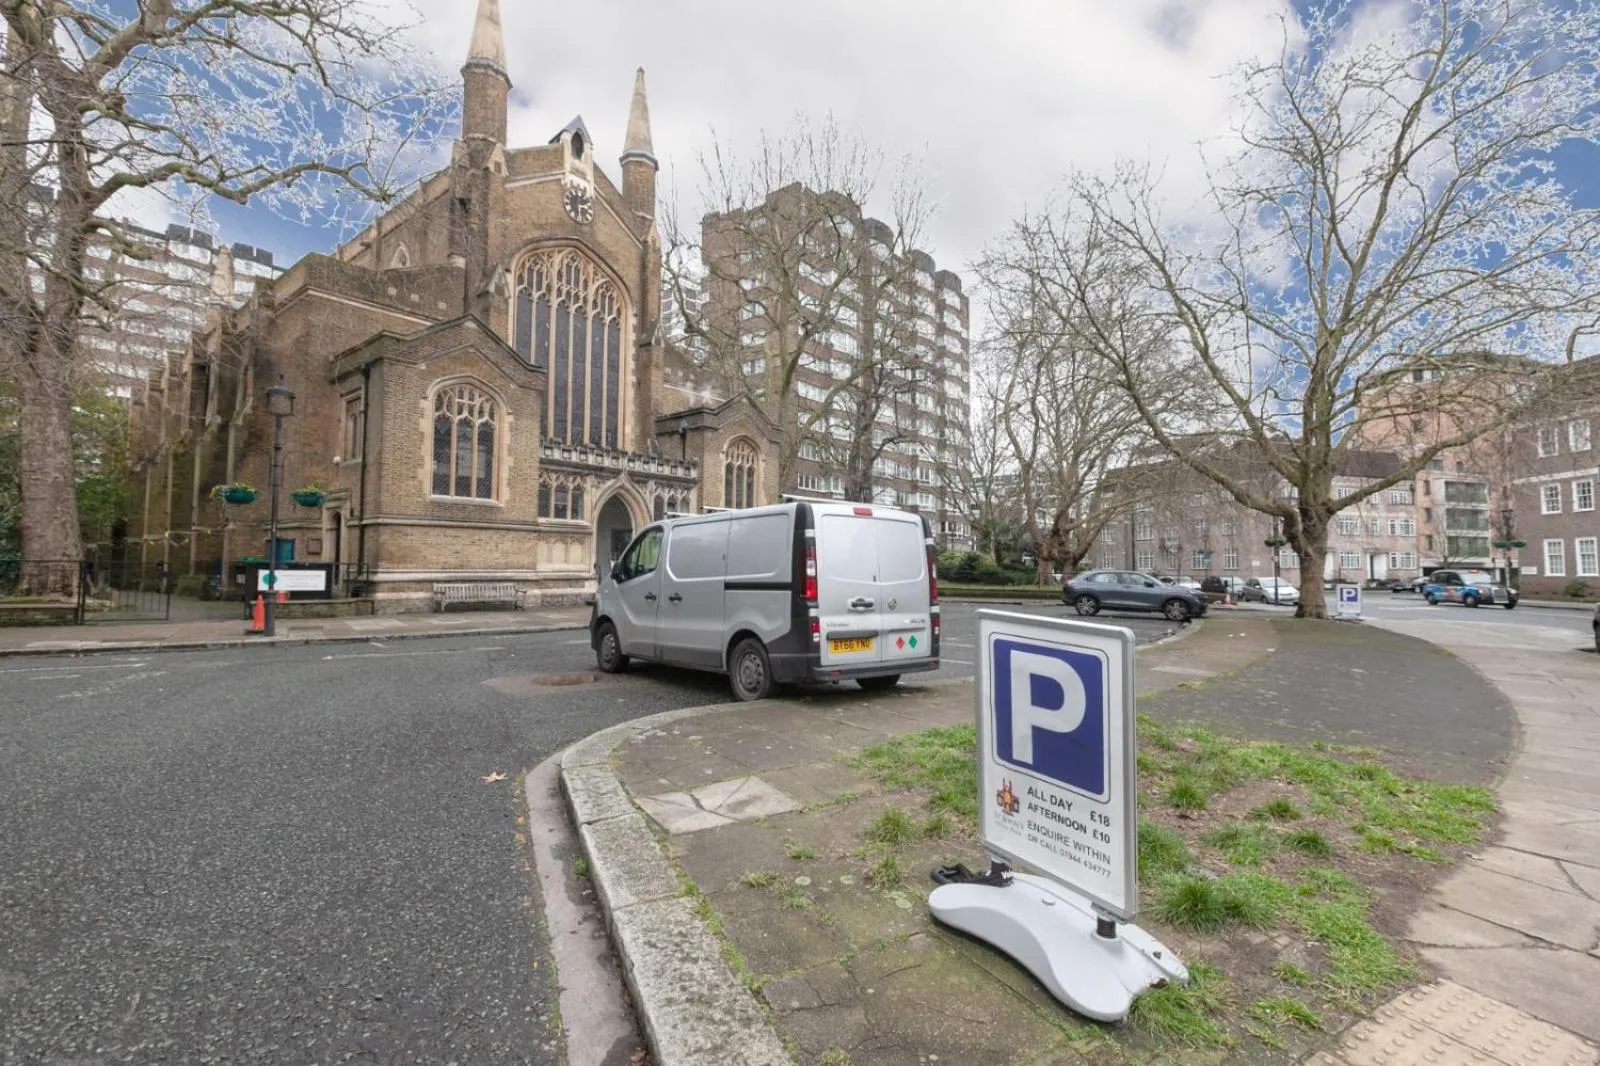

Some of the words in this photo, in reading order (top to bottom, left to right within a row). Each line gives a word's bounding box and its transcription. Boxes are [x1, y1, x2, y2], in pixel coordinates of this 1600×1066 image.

[1343, 588, 1356, 601] P
[1010, 649, 1086, 765] P
[1027, 786, 1047, 802] ALL
[1050, 795, 1073, 811] DAY
[1090, 810, 1110, 827] £18
[1027, 802, 1087, 833] AFTERNOON
[1092, 828, 1110, 844] £10
[1027, 820, 1070, 847] ENQUIRE
[1073, 840, 1110, 865] WITHIN
[1027, 833, 1038, 843] OR
[1040, 840, 1058, 853] CALL
